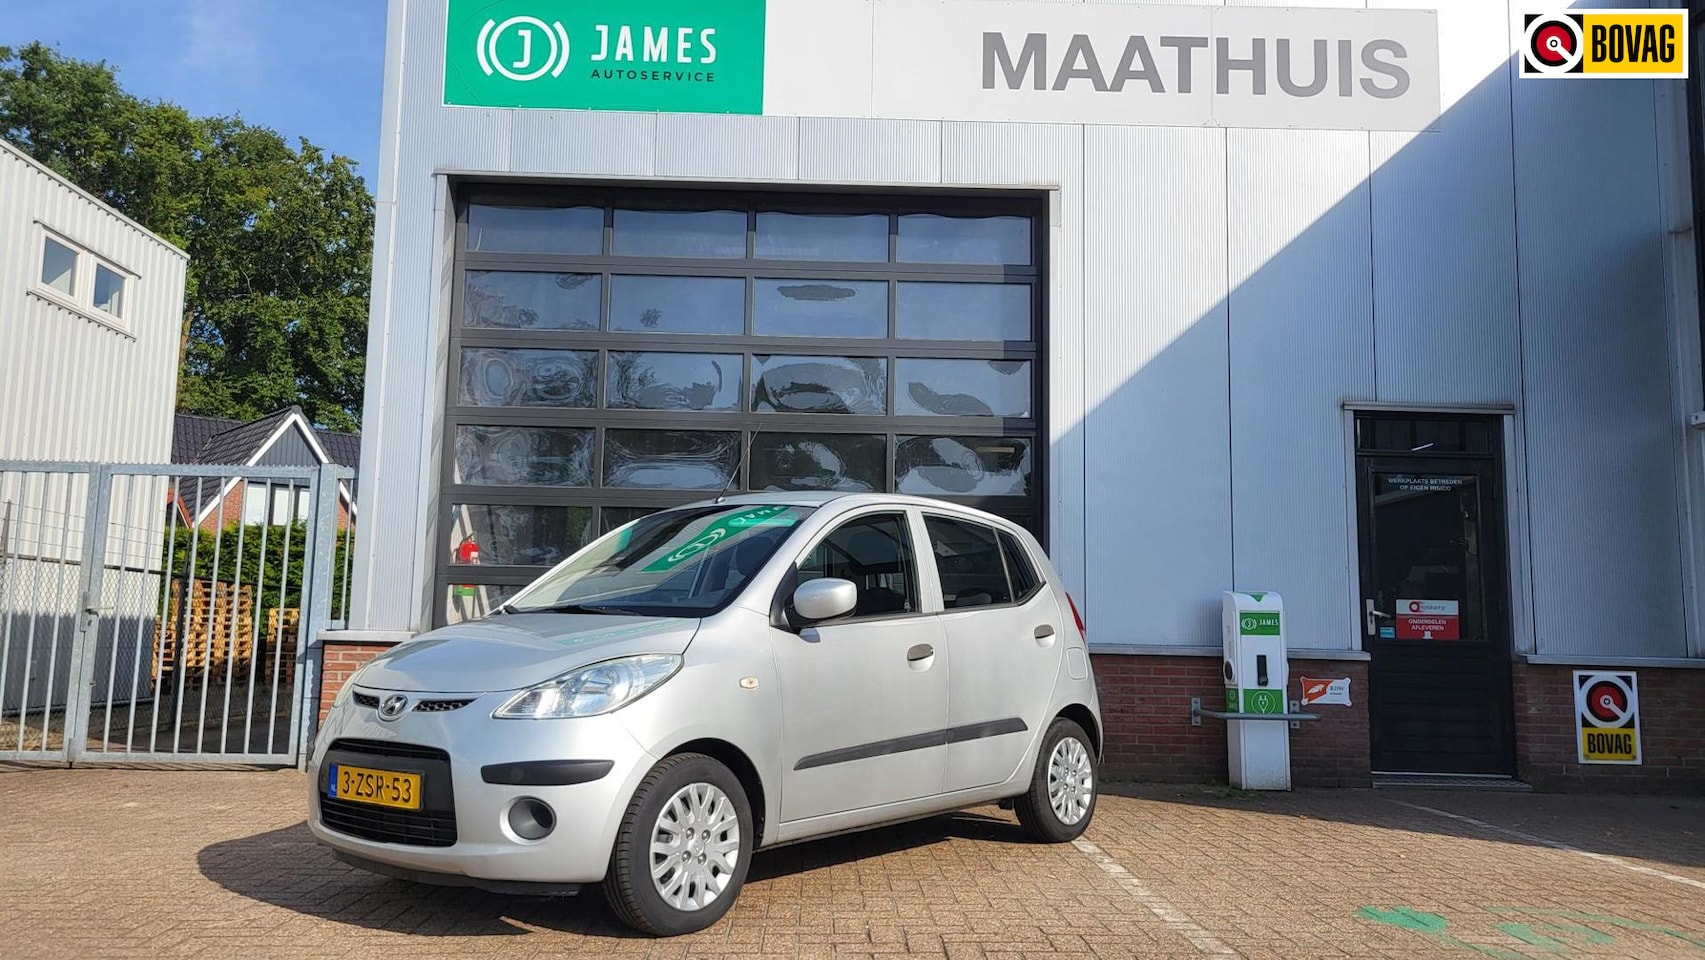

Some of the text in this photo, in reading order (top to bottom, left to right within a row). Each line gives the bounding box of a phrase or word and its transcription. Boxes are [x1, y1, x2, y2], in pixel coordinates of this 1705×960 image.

[590, 24, 717, 64] JAMES
[590, 69, 714, 82] AUTOSERVICE
[982, 32, 1410, 98] MAATHUIS
[1258, 618, 1279, 626] JAMES
[1587, 733, 1632, 754] BOVAG
[342, 771, 412, 803] 3-ZSR-53
